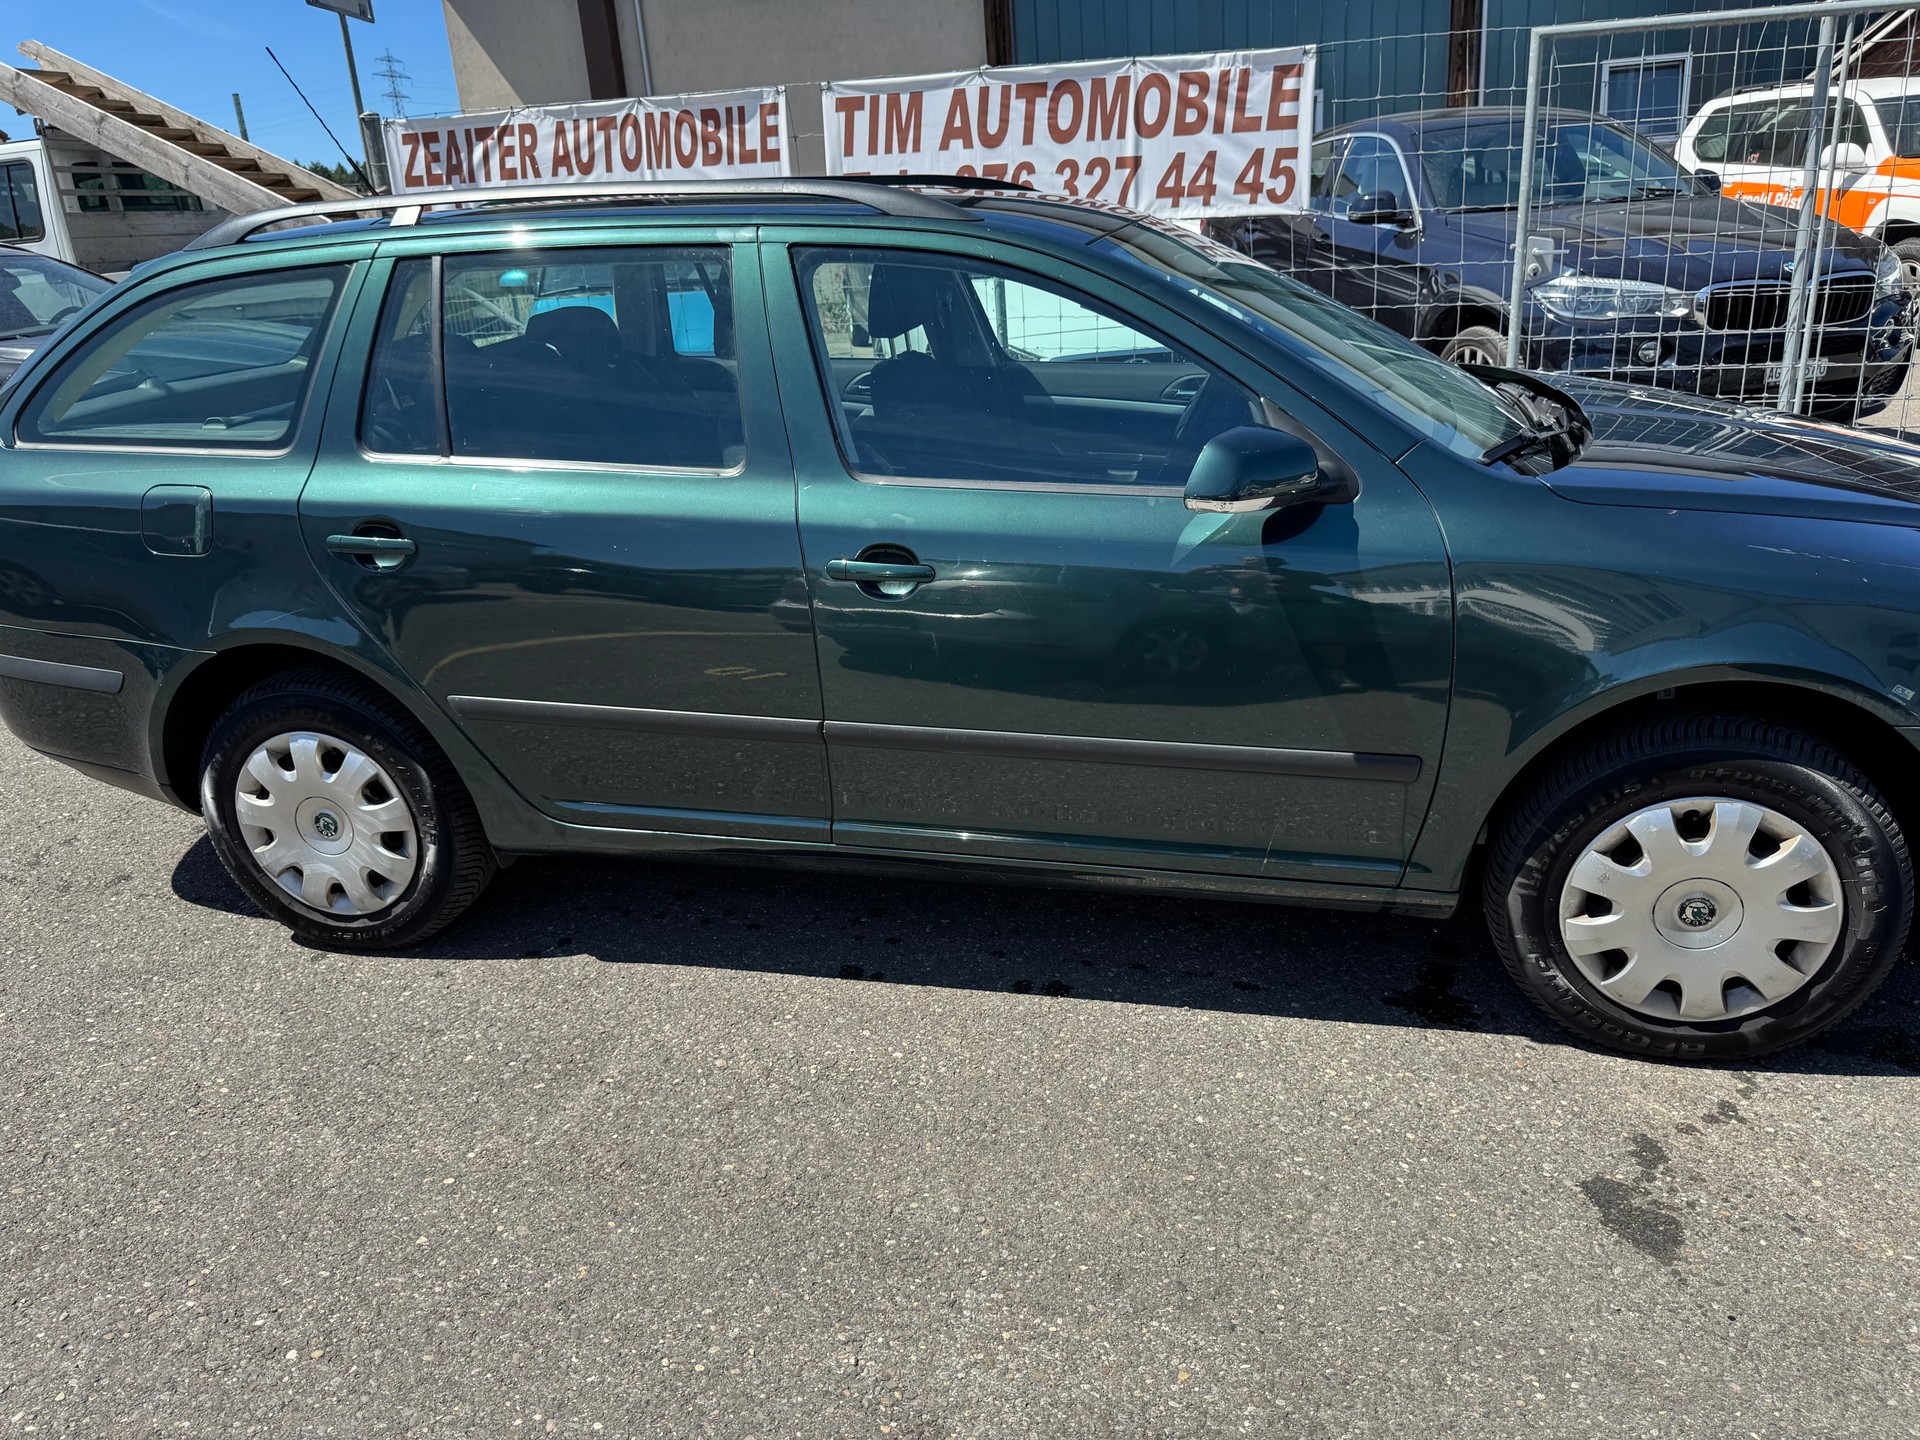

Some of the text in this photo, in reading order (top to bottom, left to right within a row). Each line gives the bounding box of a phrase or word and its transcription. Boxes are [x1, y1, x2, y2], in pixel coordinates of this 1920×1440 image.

[401, 102, 781, 188] ZEAITER AUTOMOBILE
[835, 64, 1304, 158] TIM AUTOMOBILE
[1055, 155, 1142, 208] 327
[1155, 150, 1217, 208] 44
[1233, 146, 1298, 205] 45
